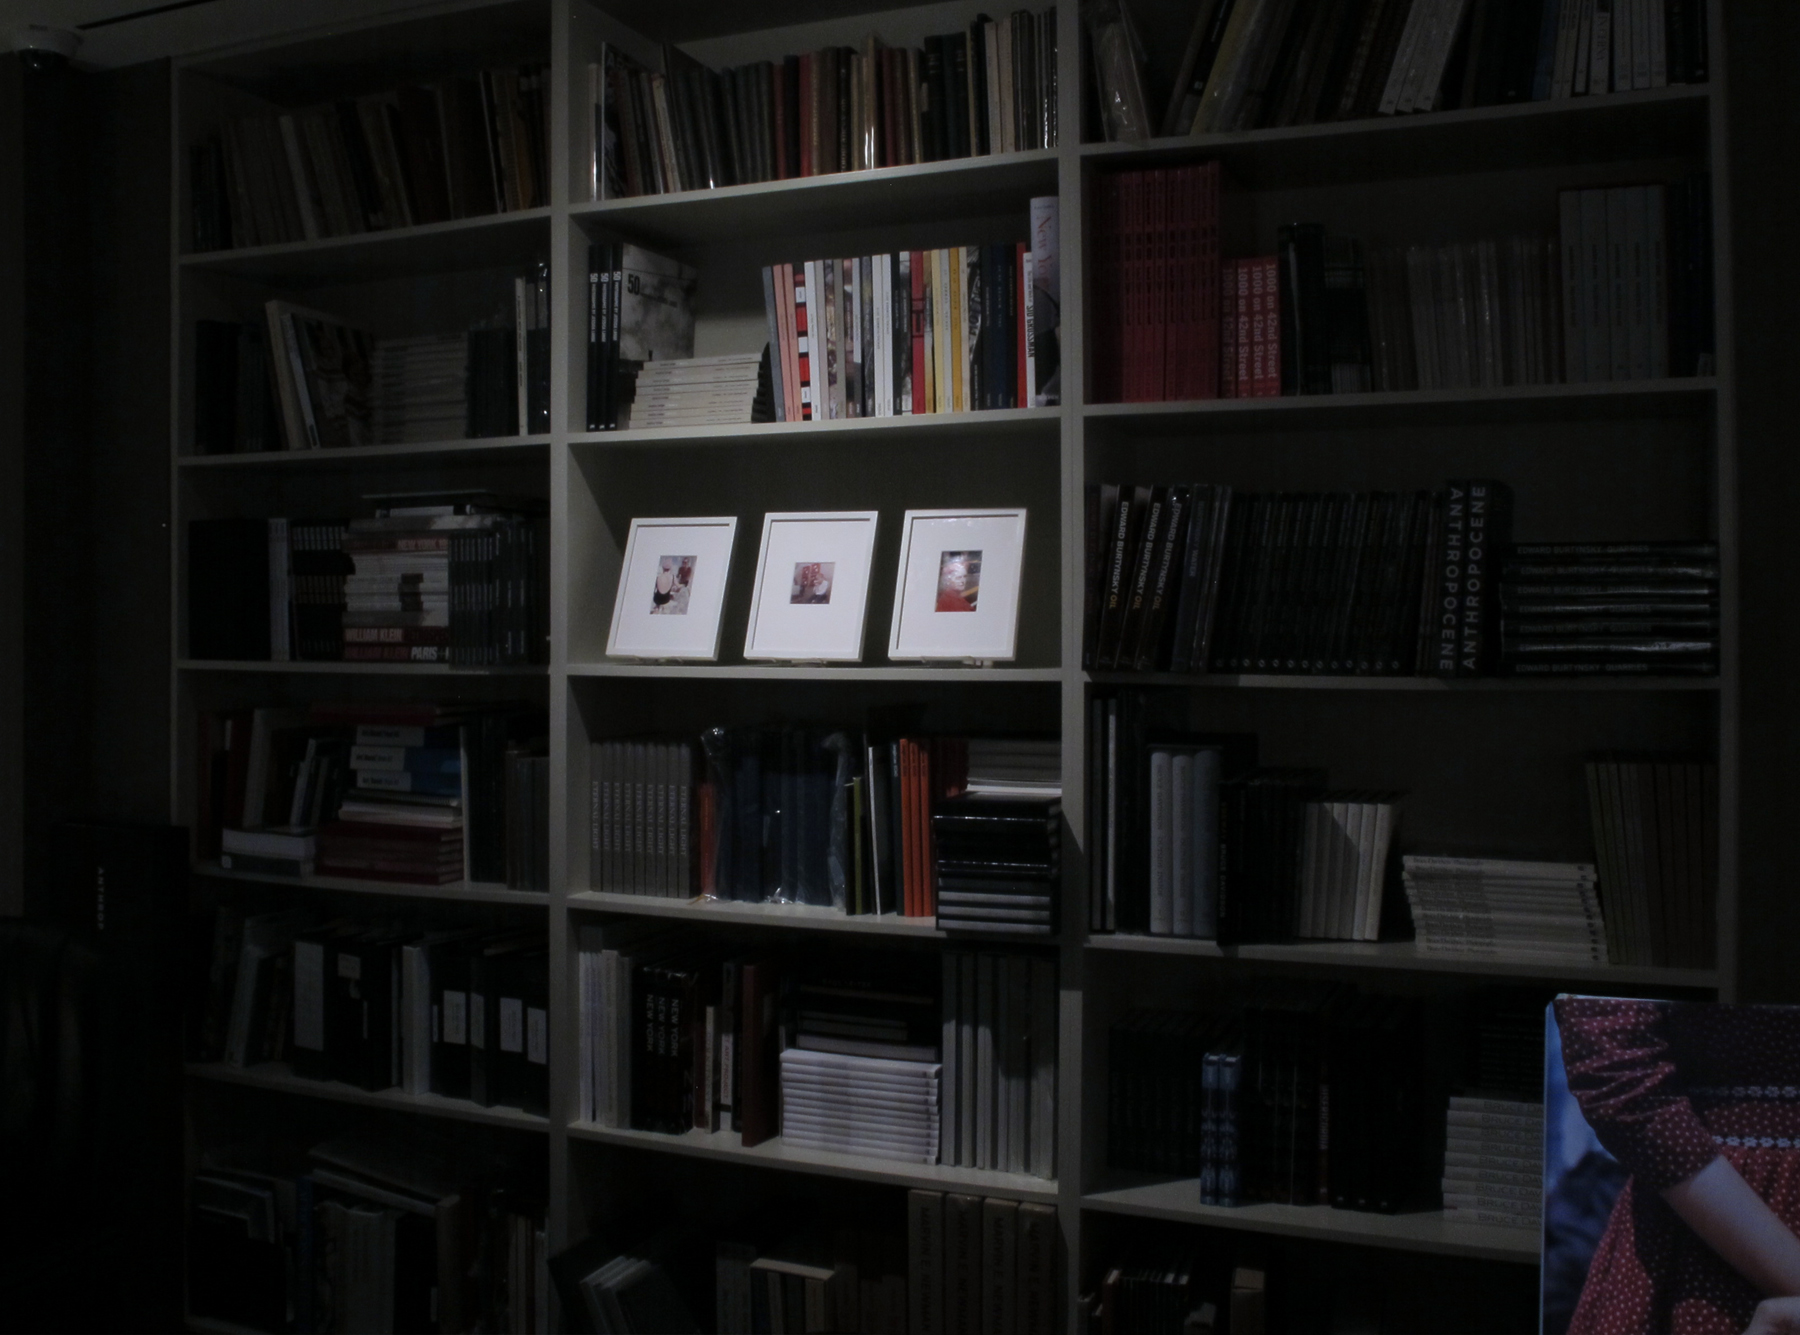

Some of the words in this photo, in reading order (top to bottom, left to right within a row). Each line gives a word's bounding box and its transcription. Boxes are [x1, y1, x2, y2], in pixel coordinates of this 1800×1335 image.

[1037, 216, 1052, 249] New
[590, 273, 598, 283] 50
[600, 272, 609, 283] 50
[613, 271, 621, 281] 50
[628, 273, 640, 295] 50
[1223, 269, 1232, 296] 1000
[1238, 268, 1248, 296] 1000
[1253, 266, 1262, 294] 1000
[1266, 264, 1276, 292] 1000
[1223, 300, 1232, 312] on
[1238, 299, 1246, 312] on
[1253, 298, 1261, 310] on
[1267, 296, 1275, 308] on
[1224, 316, 1233, 343] 42nd
[1239, 315, 1248, 343] 42nd
[1254, 314, 1263, 342] 42nd
[1267, 312, 1277, 340] 42nd
[1224, 347, 1233, 381] Street
[1239, 346, 1248, 381] Street
[1254, 344, 1264, 379] Street
[1267, 343, 1277, 378] Street
[1118, 501, 1129, 539] EDWARD
[1147, 502, 1161, 540] EDWARD
[1167, 502, 1182, 541] EDWARD
[1111, 541, 1124, 594] BURTYNSKY
[1137, 542, 1153, 595] BURTYNSKY
[1157, 542, 1173, 595] BURTYNSKY
[1189, 549, 1199, 577] WATER
[1439, 488, 1463, 670] ANTHROPOCENE
[1462, 485, 1486, 669] ANTHROPOCENE
[1109, 594, 1118, 609] OIL
[1132, 595, 1143, 609] OIL
[1152, 595, 1162, 610] OIL
[345, 628, 378, 641] WILLIAM
[380, 628, 403, 641] KLEIN
[410, 647, 438, 659] PARIS
[1516, 664, 1551, 672] EDWARD
[1482, 1115, 1522, 1124] BRUCE
[1484, 1101, 1524, 1112] BRUCE
[1481, 1129, 1522, 1138] BRUCE
[1481, 1142, 1522, 1152] BRUCE
[1479, 1157, 1520, 1166] BRUCE
[1476, 1184, 1516, 1194] BRUCE
[1479, 1171, 1519, 1181] BRUCE
[1478, 1198, 1518, 1208] BRUCE
[920, 1207, 931, 1255] MARVIN
[1478, 1213, 1518, 1223] BRUCE
[994, 1217, 1003, 1266] MARVIN
[1029, 1222, 1039, 1272] MARVIN
[921, 1274, 930, 1331] NEWMAN
